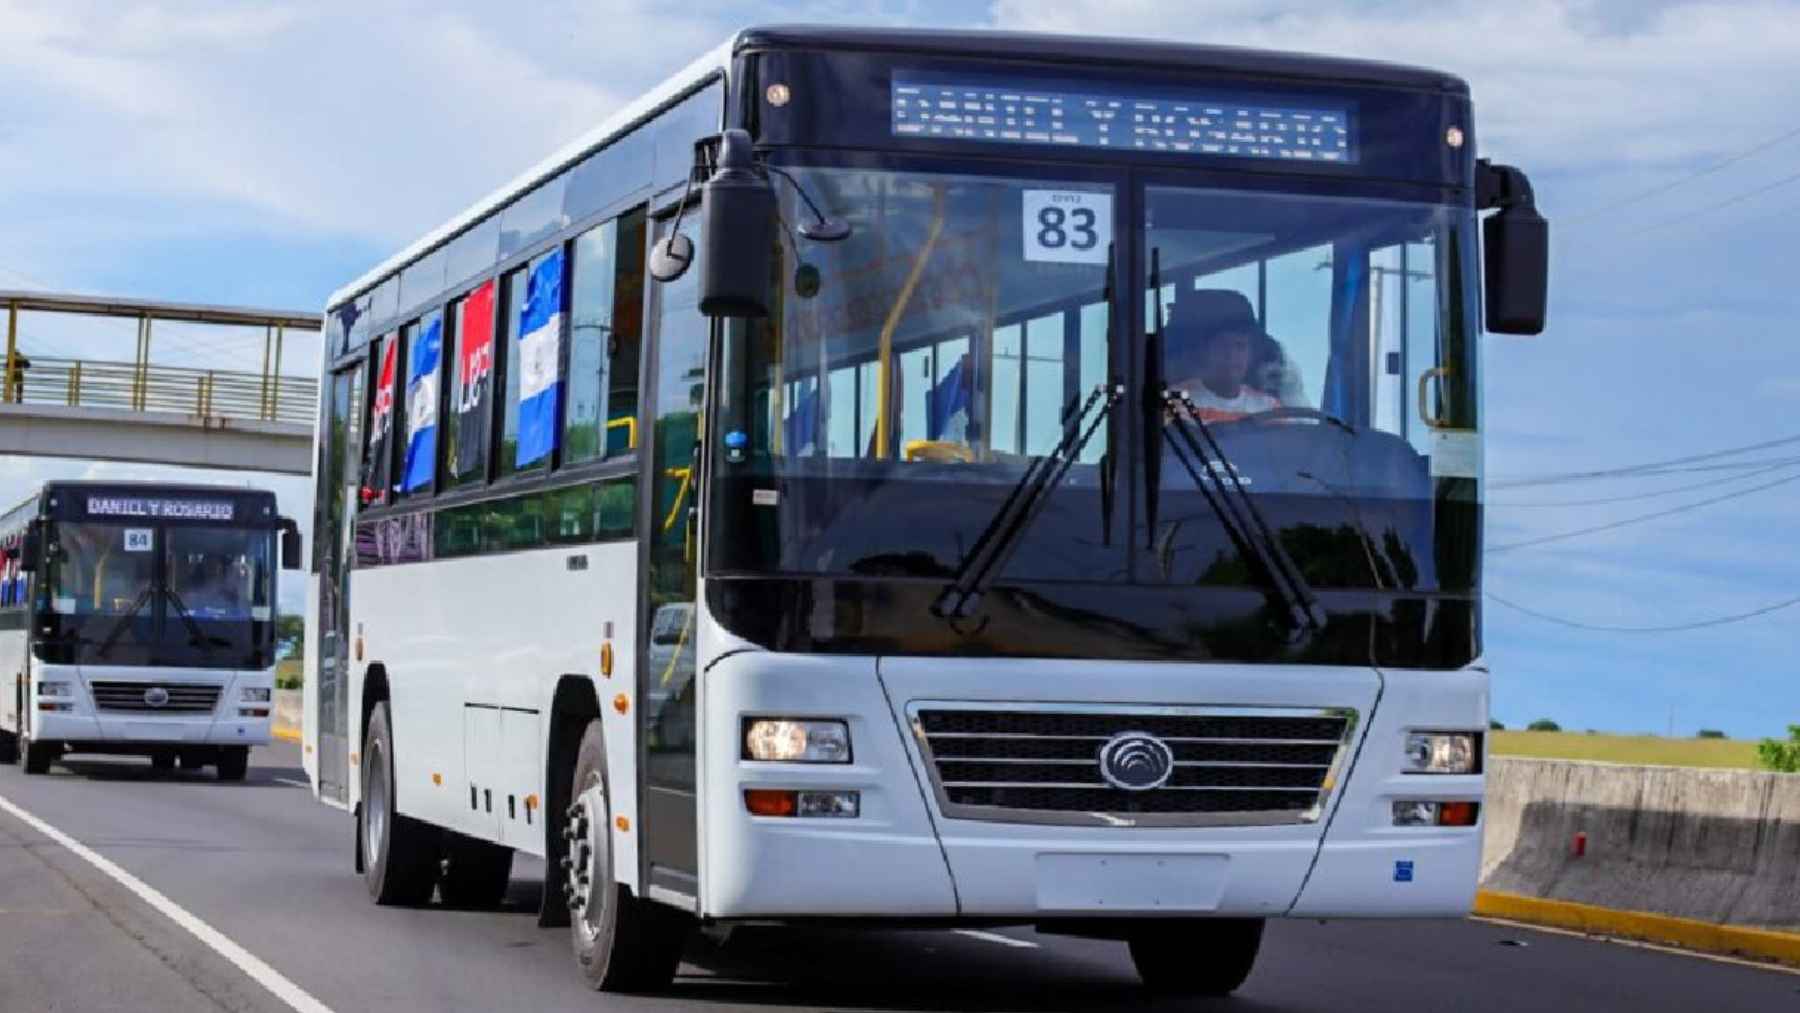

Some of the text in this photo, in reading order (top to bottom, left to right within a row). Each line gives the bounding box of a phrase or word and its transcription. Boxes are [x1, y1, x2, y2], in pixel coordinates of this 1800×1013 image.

[896, 87, 1348, 160] DANIEL Y ROSARIO
[1038, 206, 1097, 250] 83
[150, 502, 159, 516] Y
[163, 502, 233, 519] ROSARIO
[128, 533, 147, 546] 84
